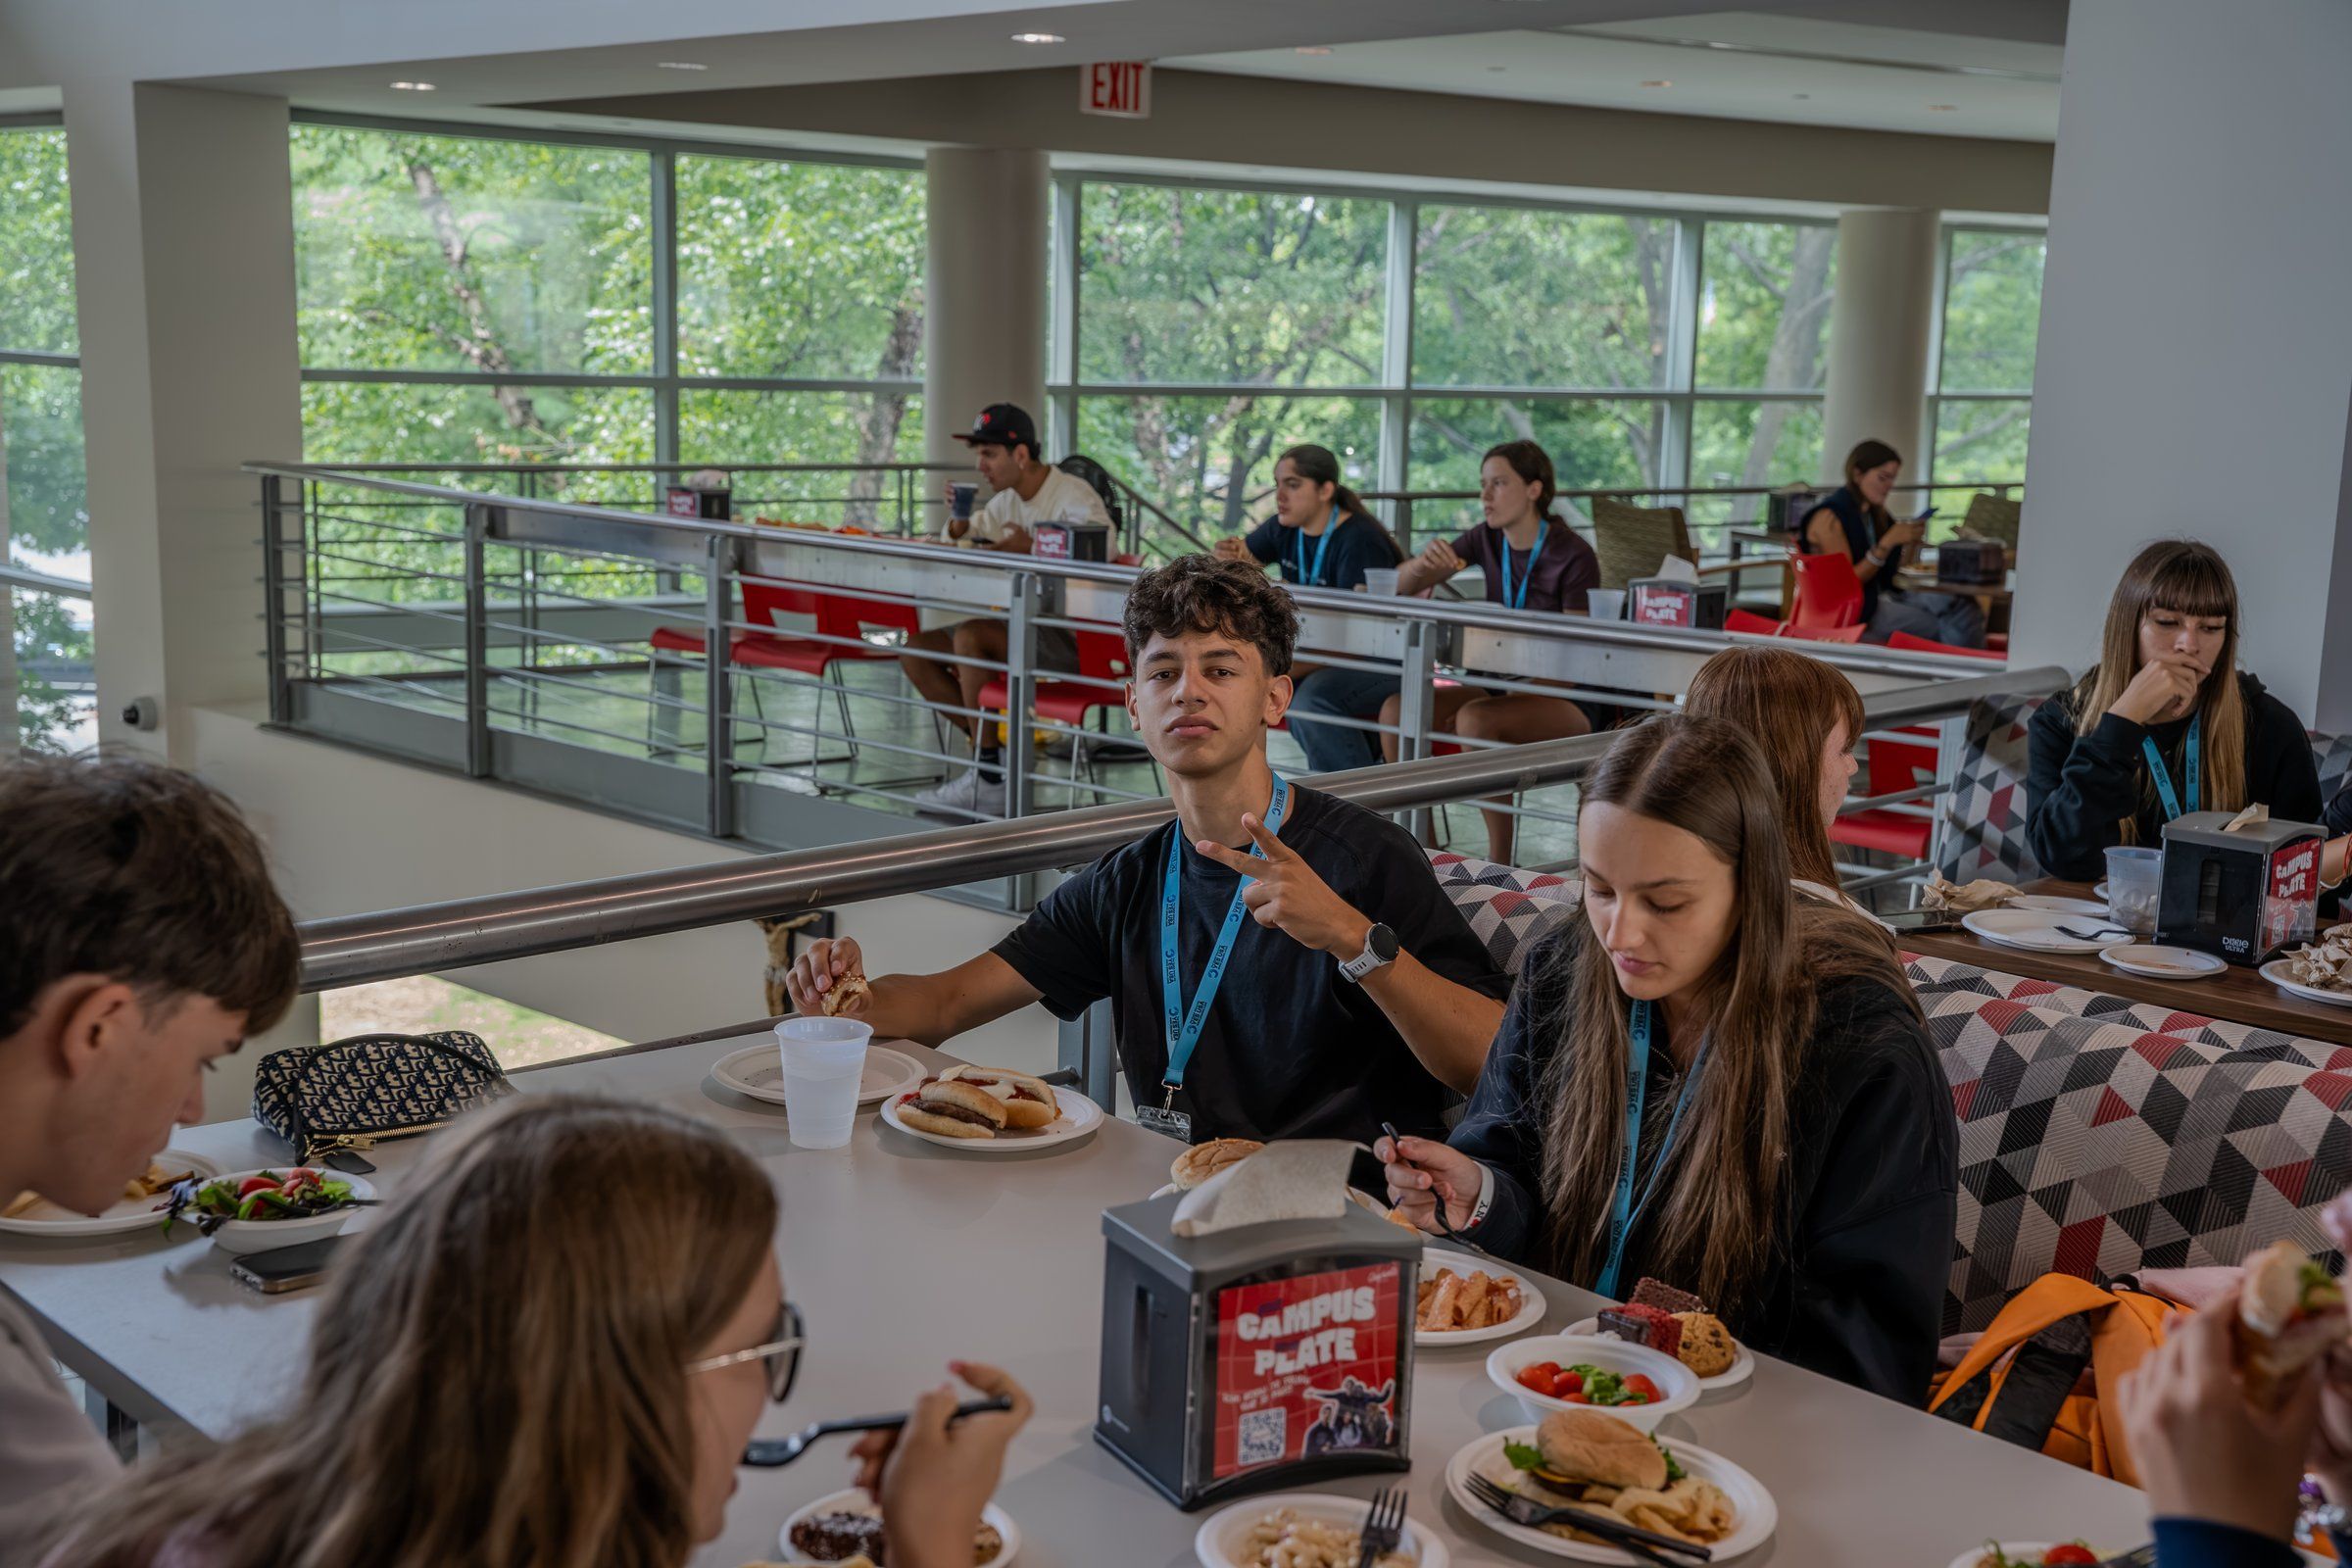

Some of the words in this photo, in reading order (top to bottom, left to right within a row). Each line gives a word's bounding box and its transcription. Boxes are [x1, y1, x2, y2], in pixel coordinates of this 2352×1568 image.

[1092, 61, 1145, 111] EXIT
[2276, 850, 2313, 879] CAMPUS
[2278, 872, 2306, 898] PLATE
[2225, 944, 2245, 954] ULTRA
[1474, 1200, 1490, 1218] NY
[1237, 1286, 1377, 1342] CAMPUS
[1253, 1327, 1357, 1377] PLATE
